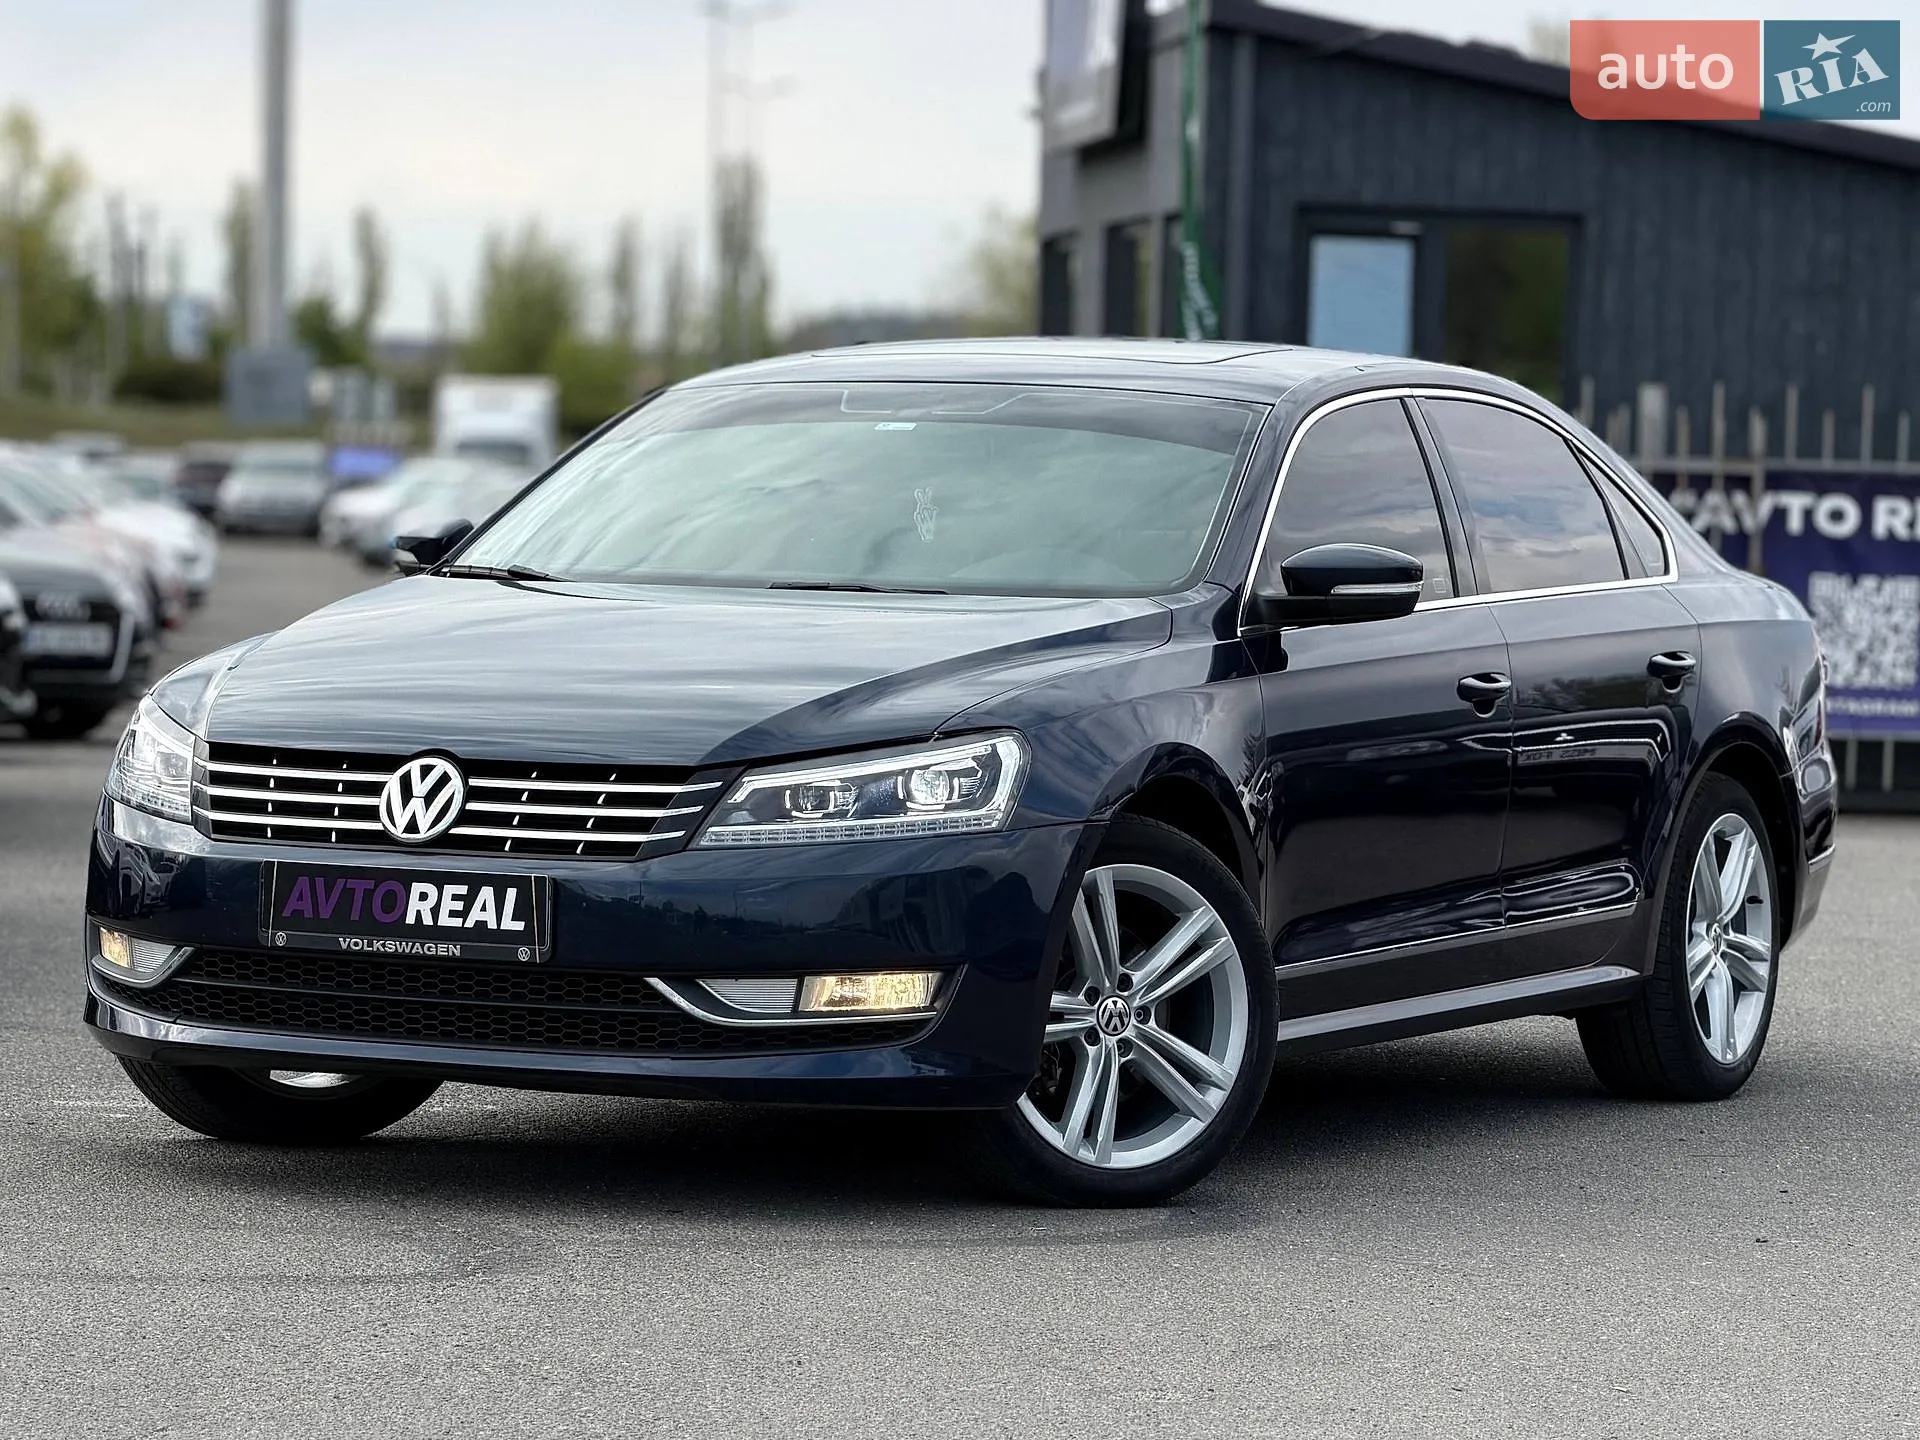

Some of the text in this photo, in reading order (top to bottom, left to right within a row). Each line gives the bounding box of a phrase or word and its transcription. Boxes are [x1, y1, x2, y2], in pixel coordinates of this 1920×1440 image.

[1690, 488, 1863, 539] AVTO
[282, 876, 526, 932] AVTOREAL
[338, 937, 462, 957] VOLKSWAGEN
